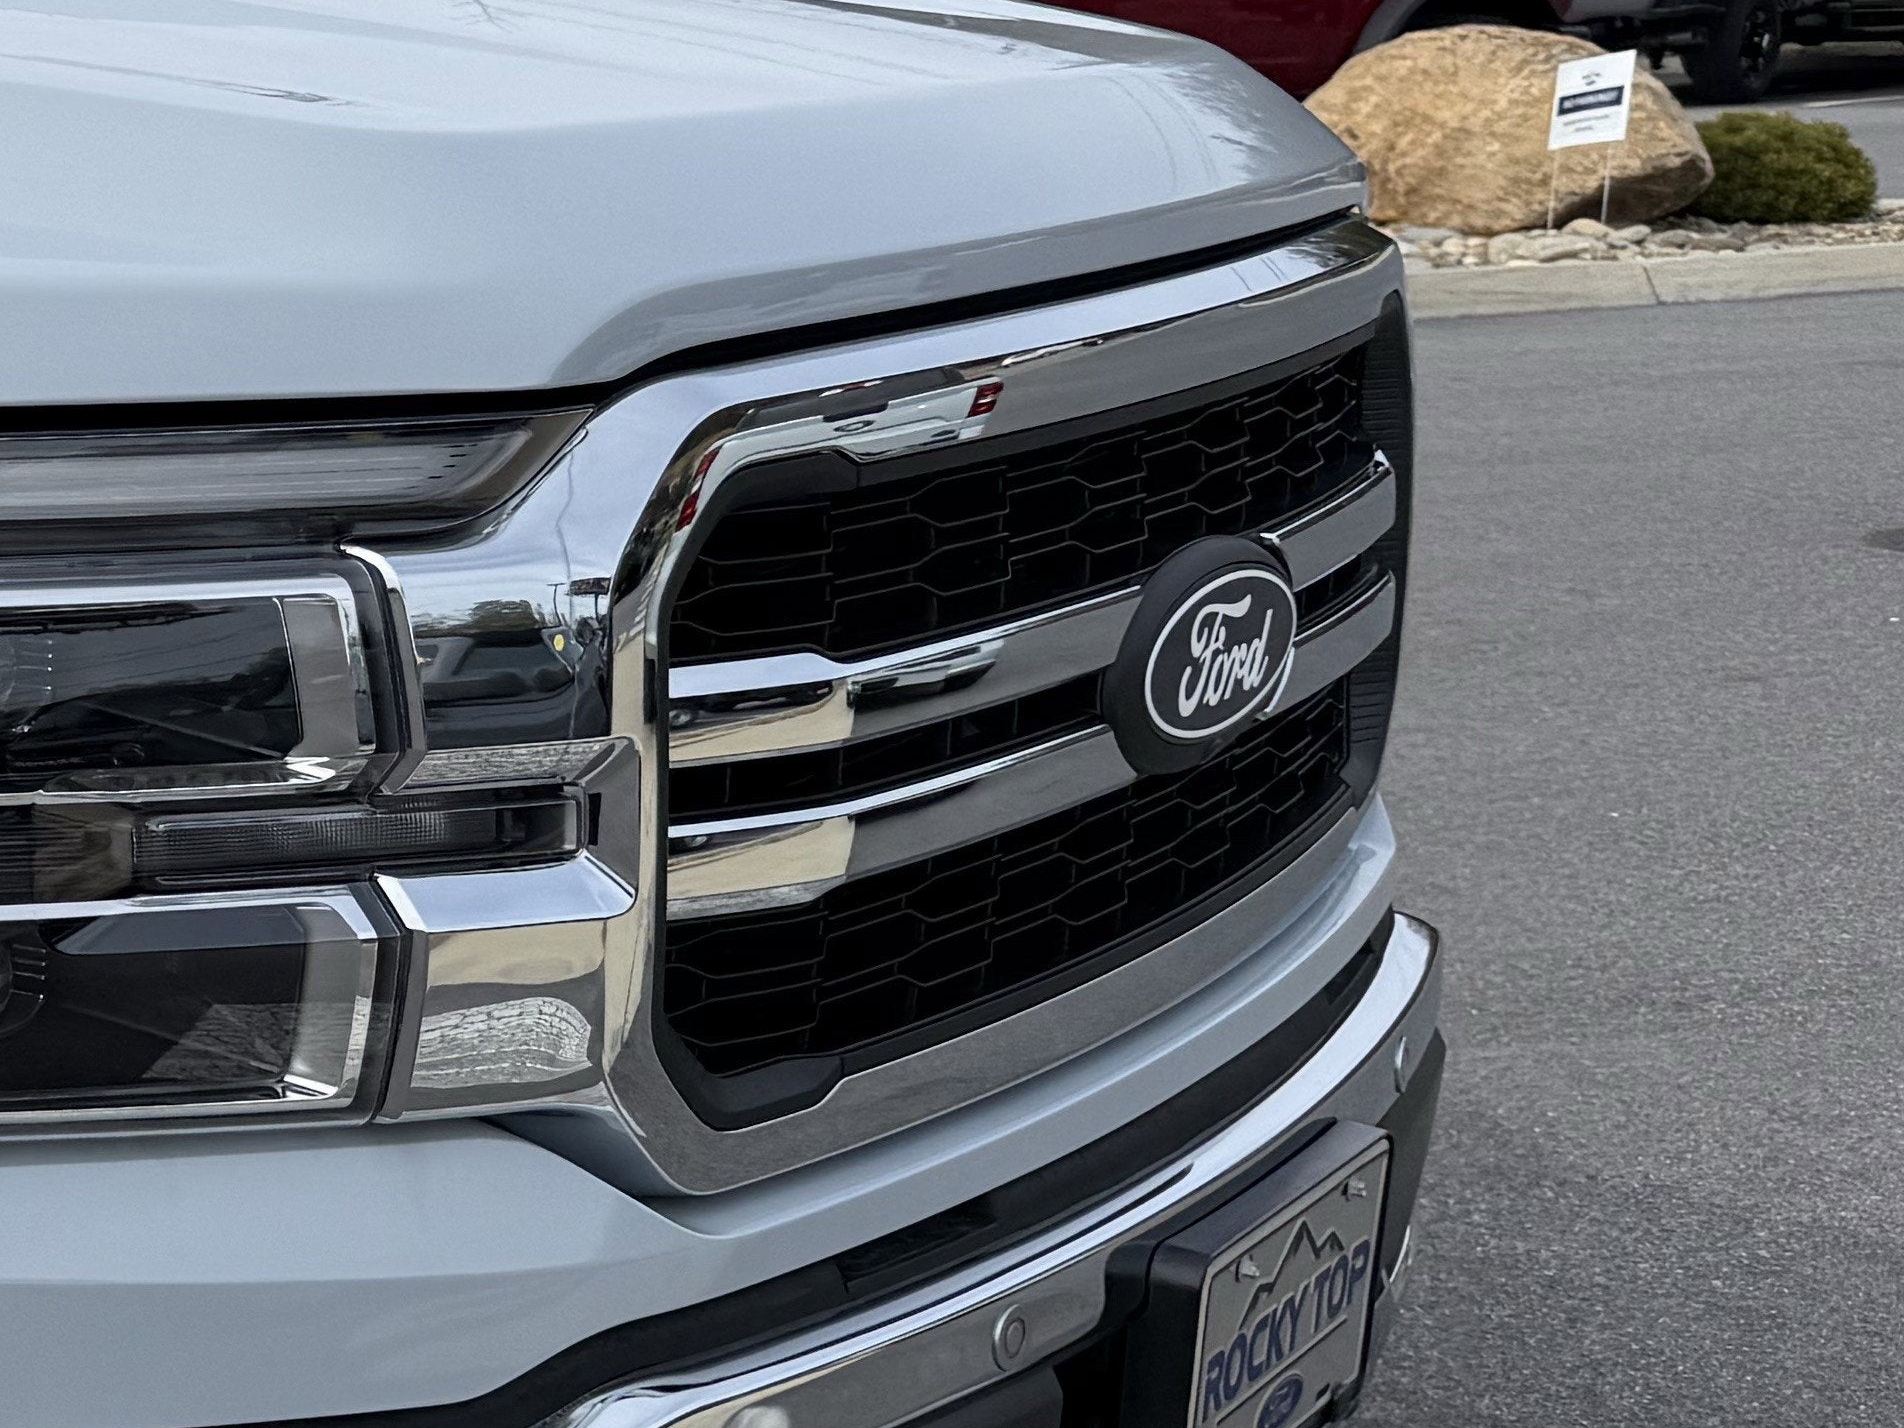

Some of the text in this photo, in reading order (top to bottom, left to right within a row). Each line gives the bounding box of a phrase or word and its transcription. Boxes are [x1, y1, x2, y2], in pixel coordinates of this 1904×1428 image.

[1177, 593, 1274, 718] Ford
[1201, 1237, 1371, 1424] ROCKY TOP
